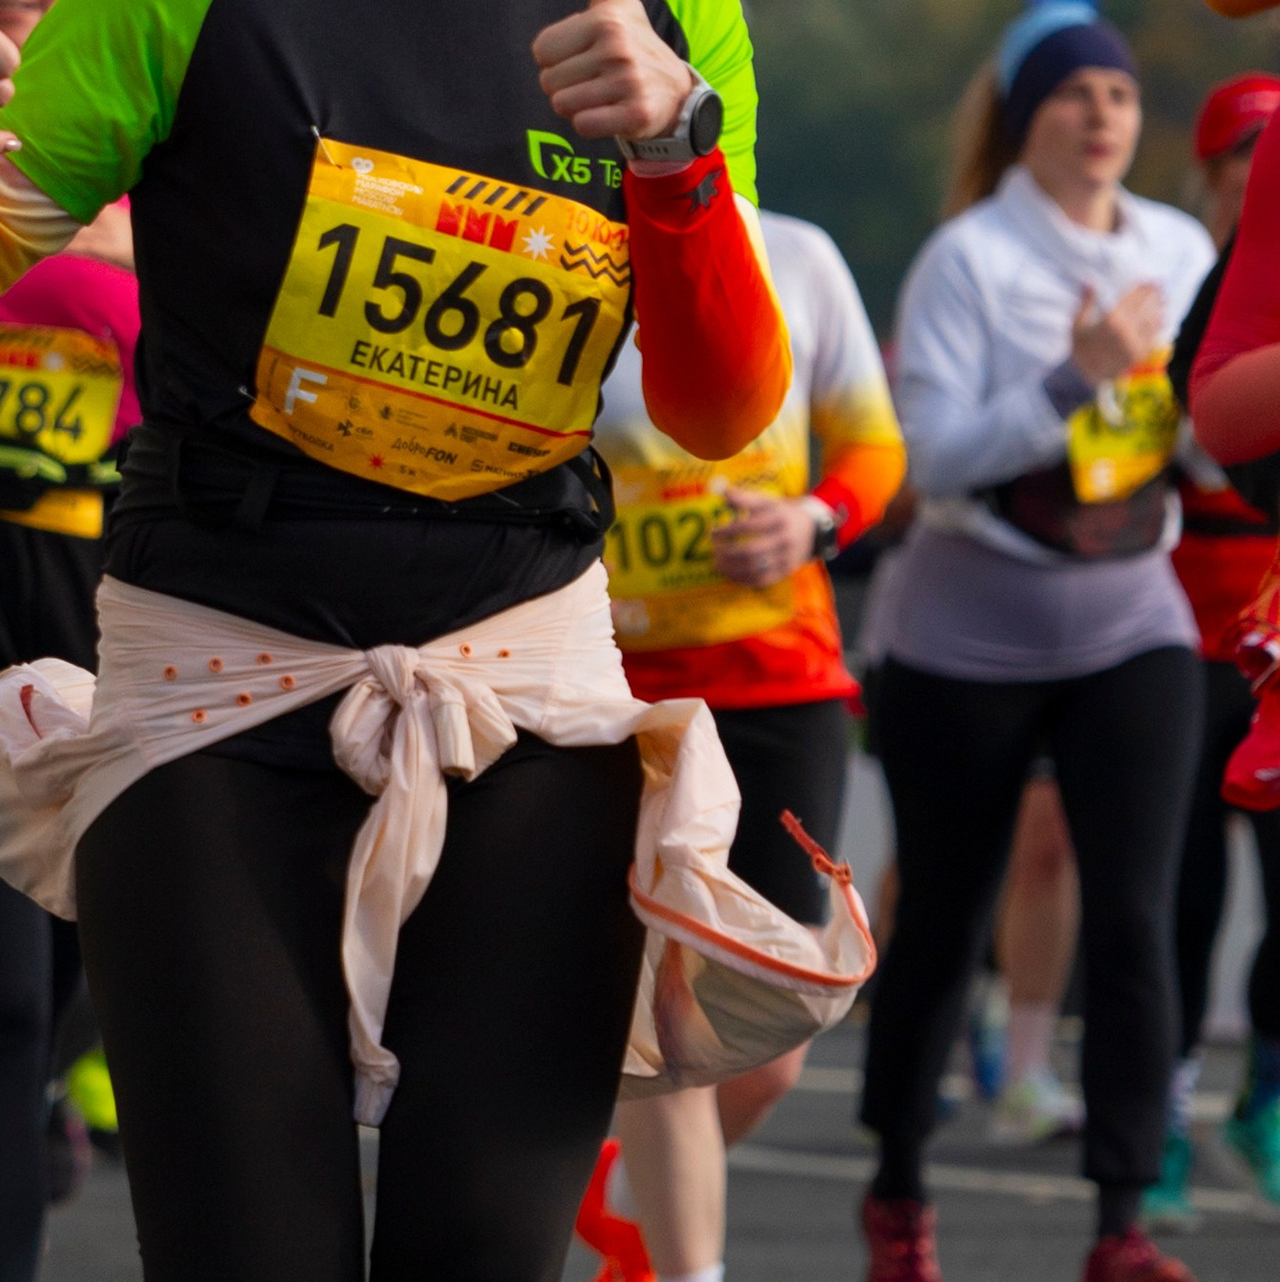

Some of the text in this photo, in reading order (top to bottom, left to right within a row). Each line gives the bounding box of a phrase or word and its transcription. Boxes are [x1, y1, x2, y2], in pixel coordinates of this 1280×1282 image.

[317, 222, 602, 387] 15681
[284, 365, 328, 416] F
[350, 340, 519, 411] ЕКАТЕРИНА
[609, 505, 738, 573] 102
